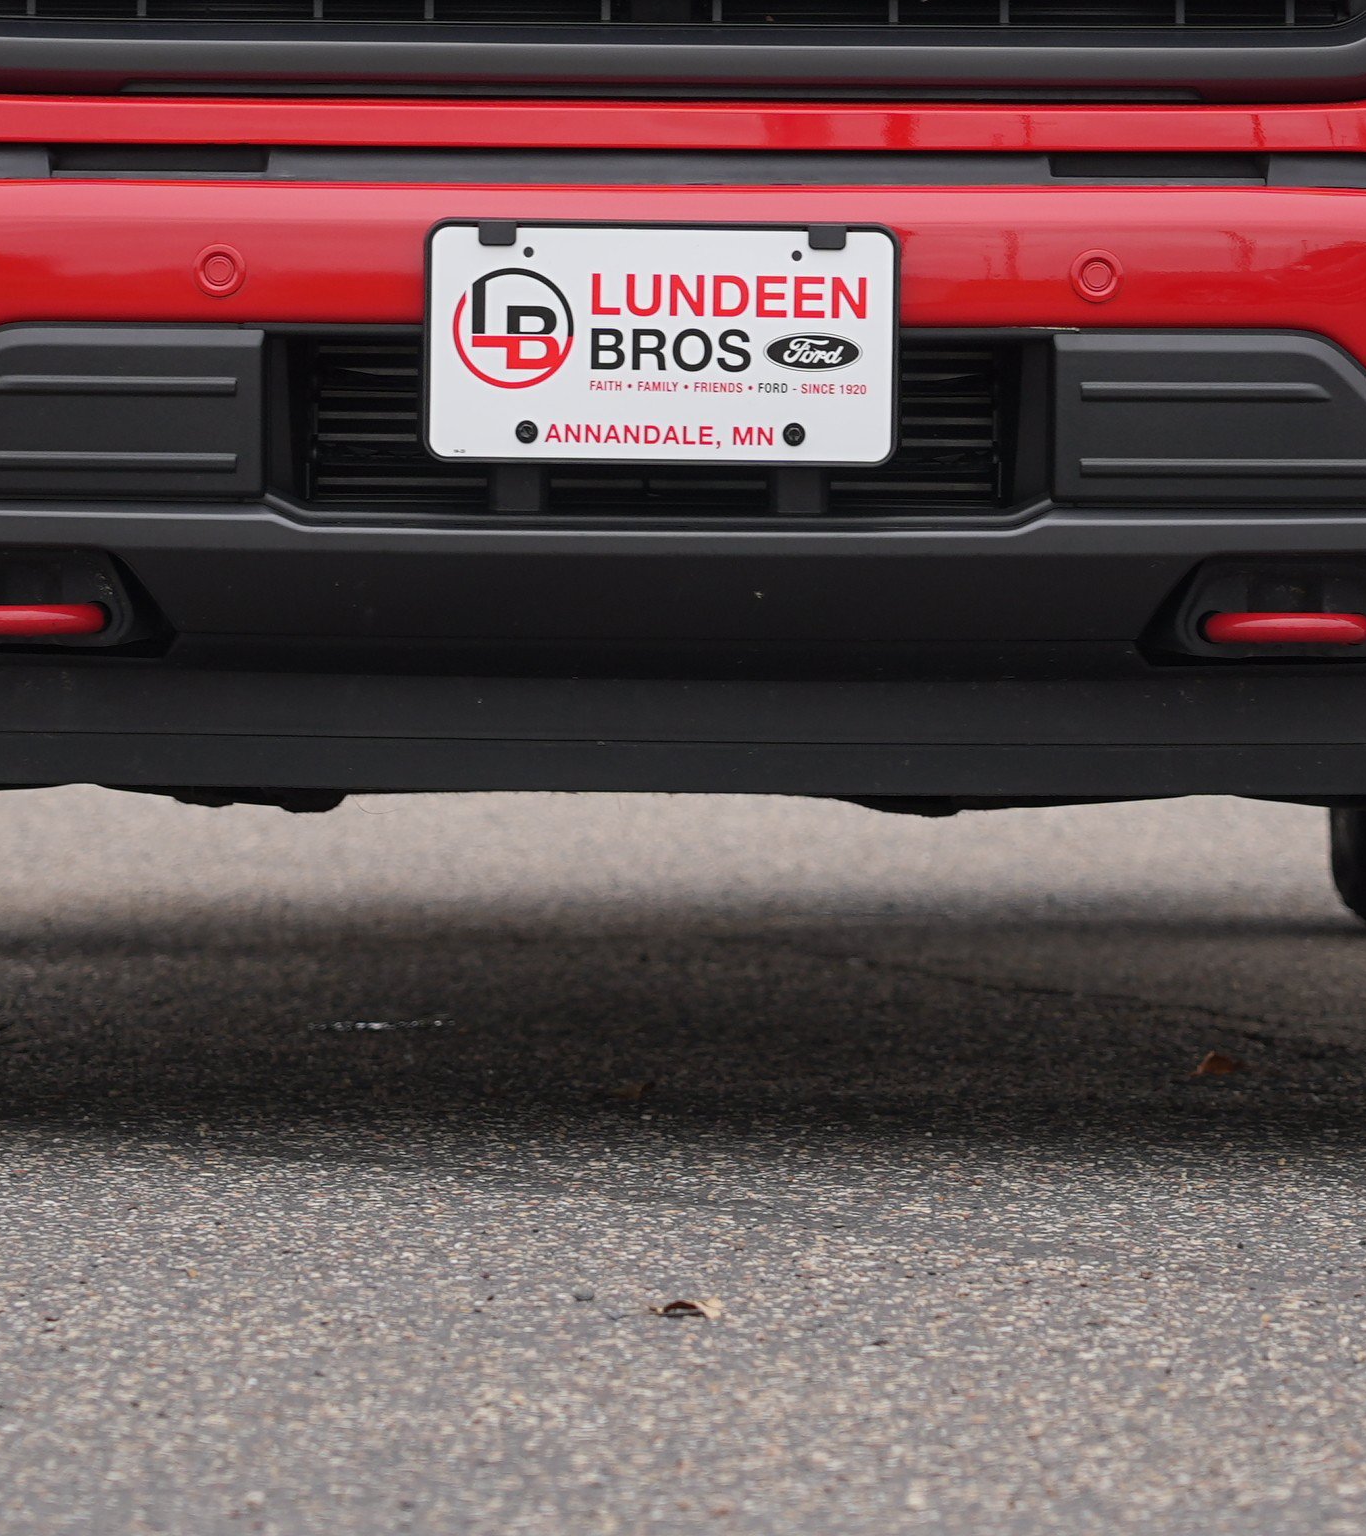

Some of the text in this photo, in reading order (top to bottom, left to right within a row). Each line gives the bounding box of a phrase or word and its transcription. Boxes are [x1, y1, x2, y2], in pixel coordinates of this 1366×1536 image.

[591, 272, 867, 320] LUNDEEN
[590, 327, 752, 373] BROS
[782, 337, 845, 364] Ford
[589, 380, 867, 395] FAITH FAMILY FRIENDS FORD SINCE 1920
[544, 423, 774, 450] ANNANDALE, MN
